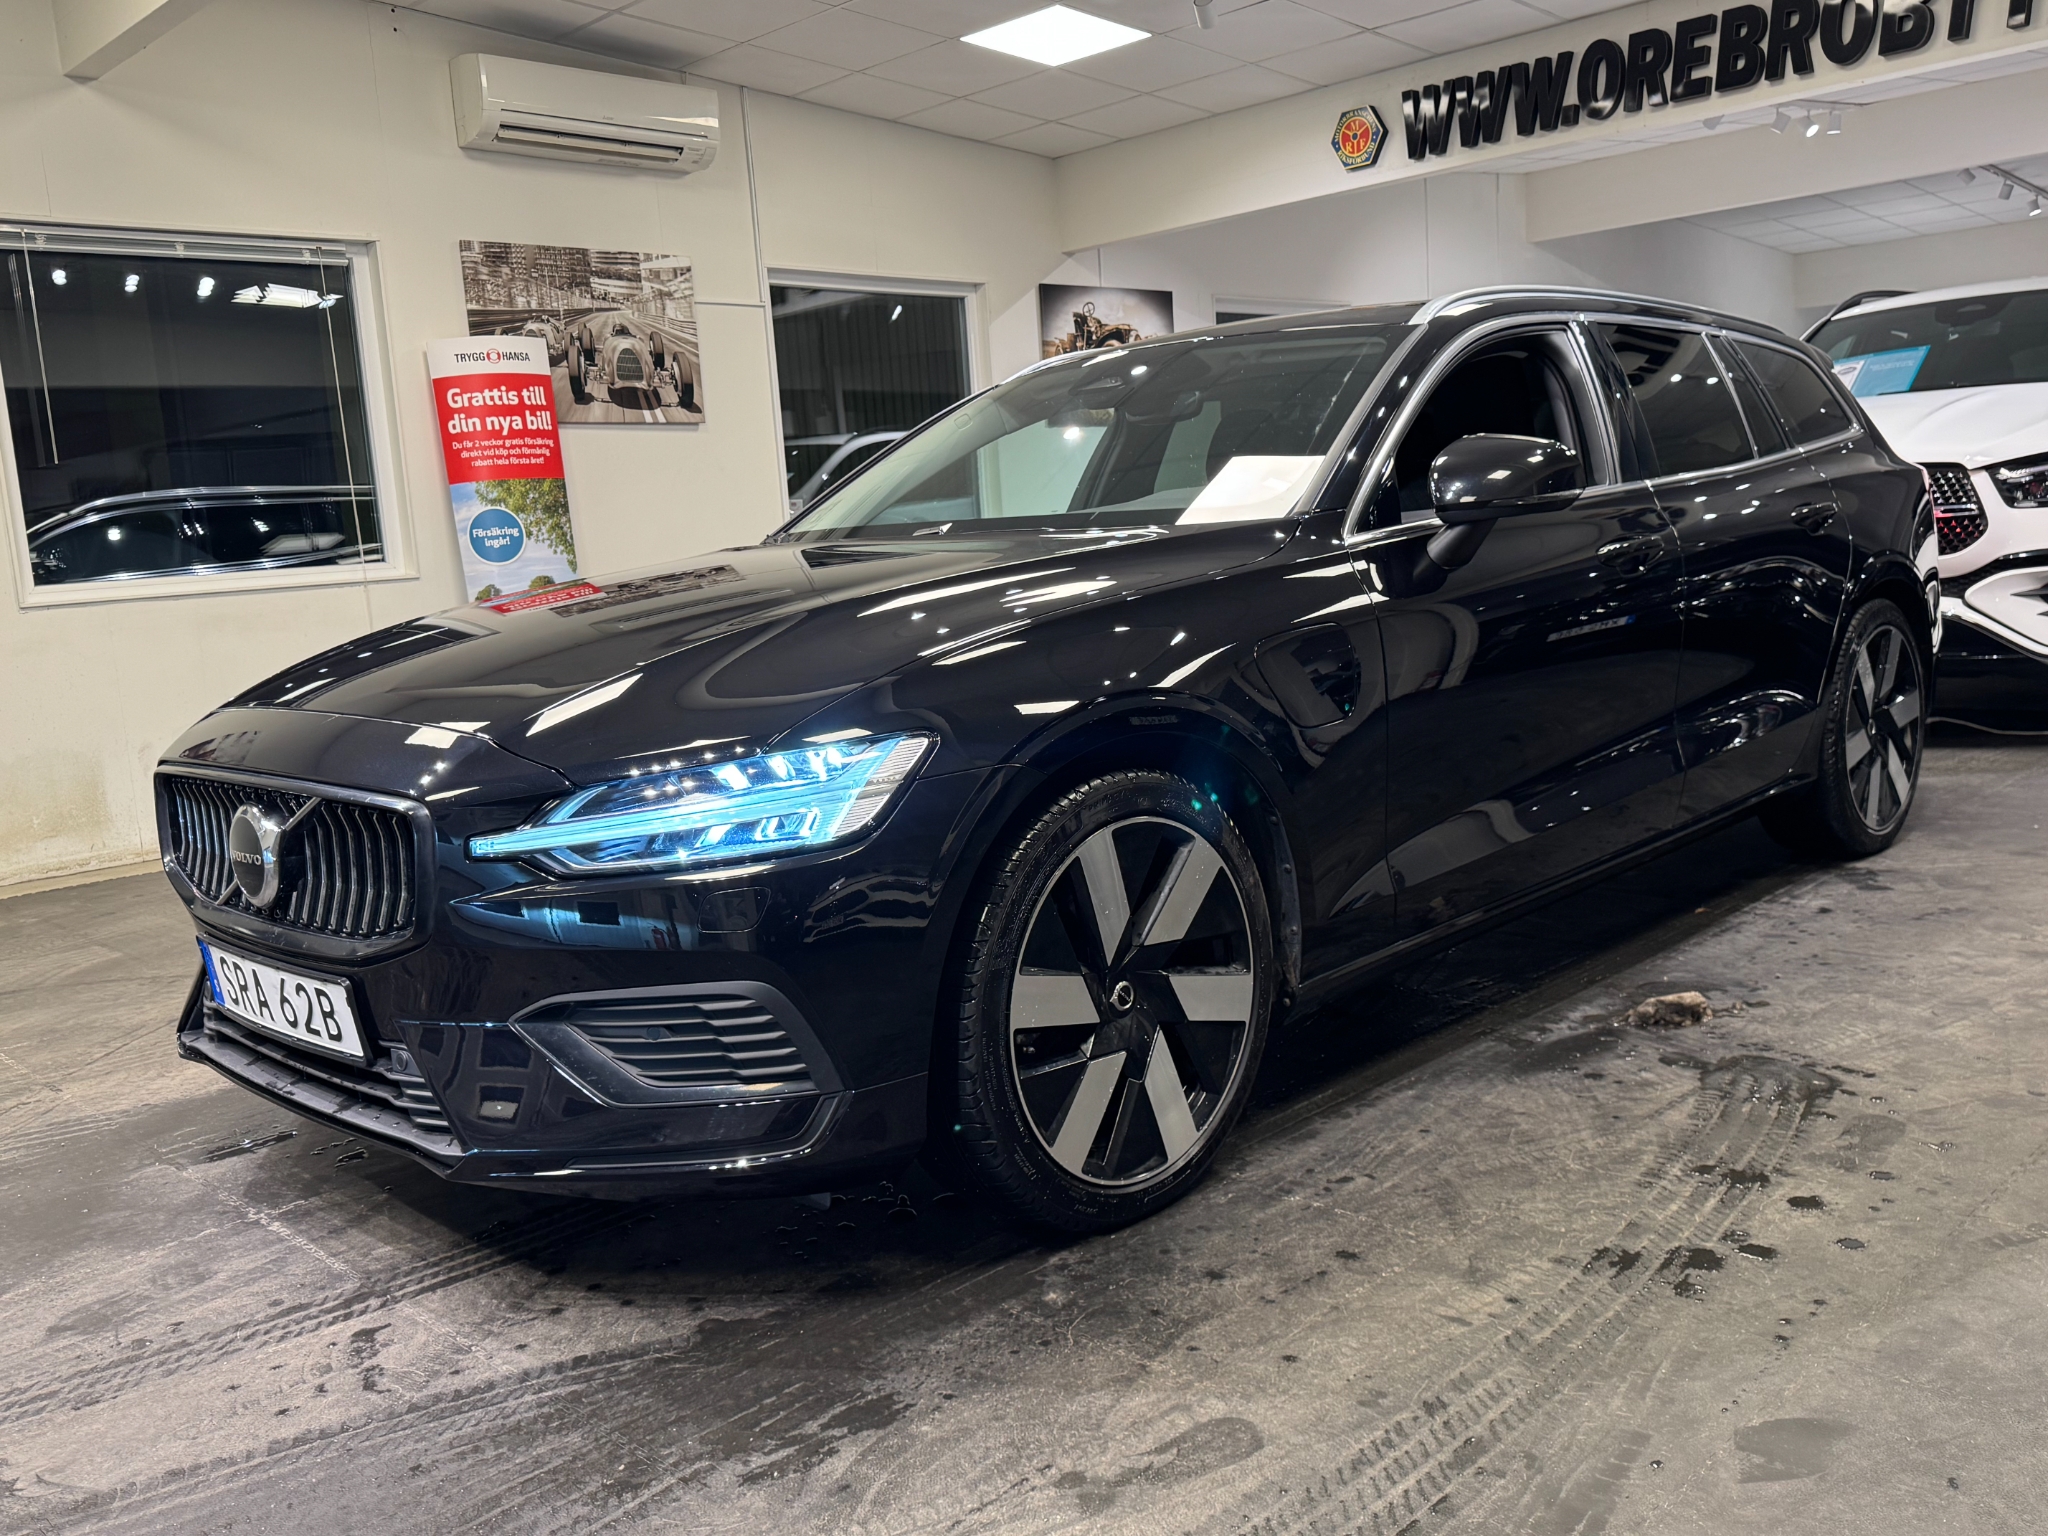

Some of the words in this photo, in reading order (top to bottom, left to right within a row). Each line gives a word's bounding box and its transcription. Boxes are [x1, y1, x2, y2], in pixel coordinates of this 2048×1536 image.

[1401, 0, 2033, 161] WWW.OREBROB
[454, 352, 486, 363] TRYGG
[502, 351, 531, 362] HANSA
[446, 385, 519, 409] Grattis
[521, 385, 547, 406] till
[447, 413, 482, 434] din
[485, 415, 523, 436] nya
[525, 410, 553, 431] bil!
[452, 441, 463, 449] Du
[463, 440, 473, 448] får
[480, 438, 504, 447] veckor
[505, 437, 524, 447] gratis
[524, 437, 554, 447] försäkring
[461, 450, 482, 458] direkt
[483, 448, 495, 456] vid
[495, 447, 508, 456] köp
[509, 447, 521, 455] och
[522, 447, 551, 456] förmånlig
[471, 459, 493, 467] rabatt
[494, 457, 509, 465] hela
[510, 456, 530, 464] första
[530, 456, 545, 464] året!
[472, 526, 520, 538] Försäkring
[484, 535, 511, 549] ingår!
[231, 850, 262, 866] VOLVO
[219, 955, 275, 1022] SRA
[279, 977, 343, 1043] 62B
